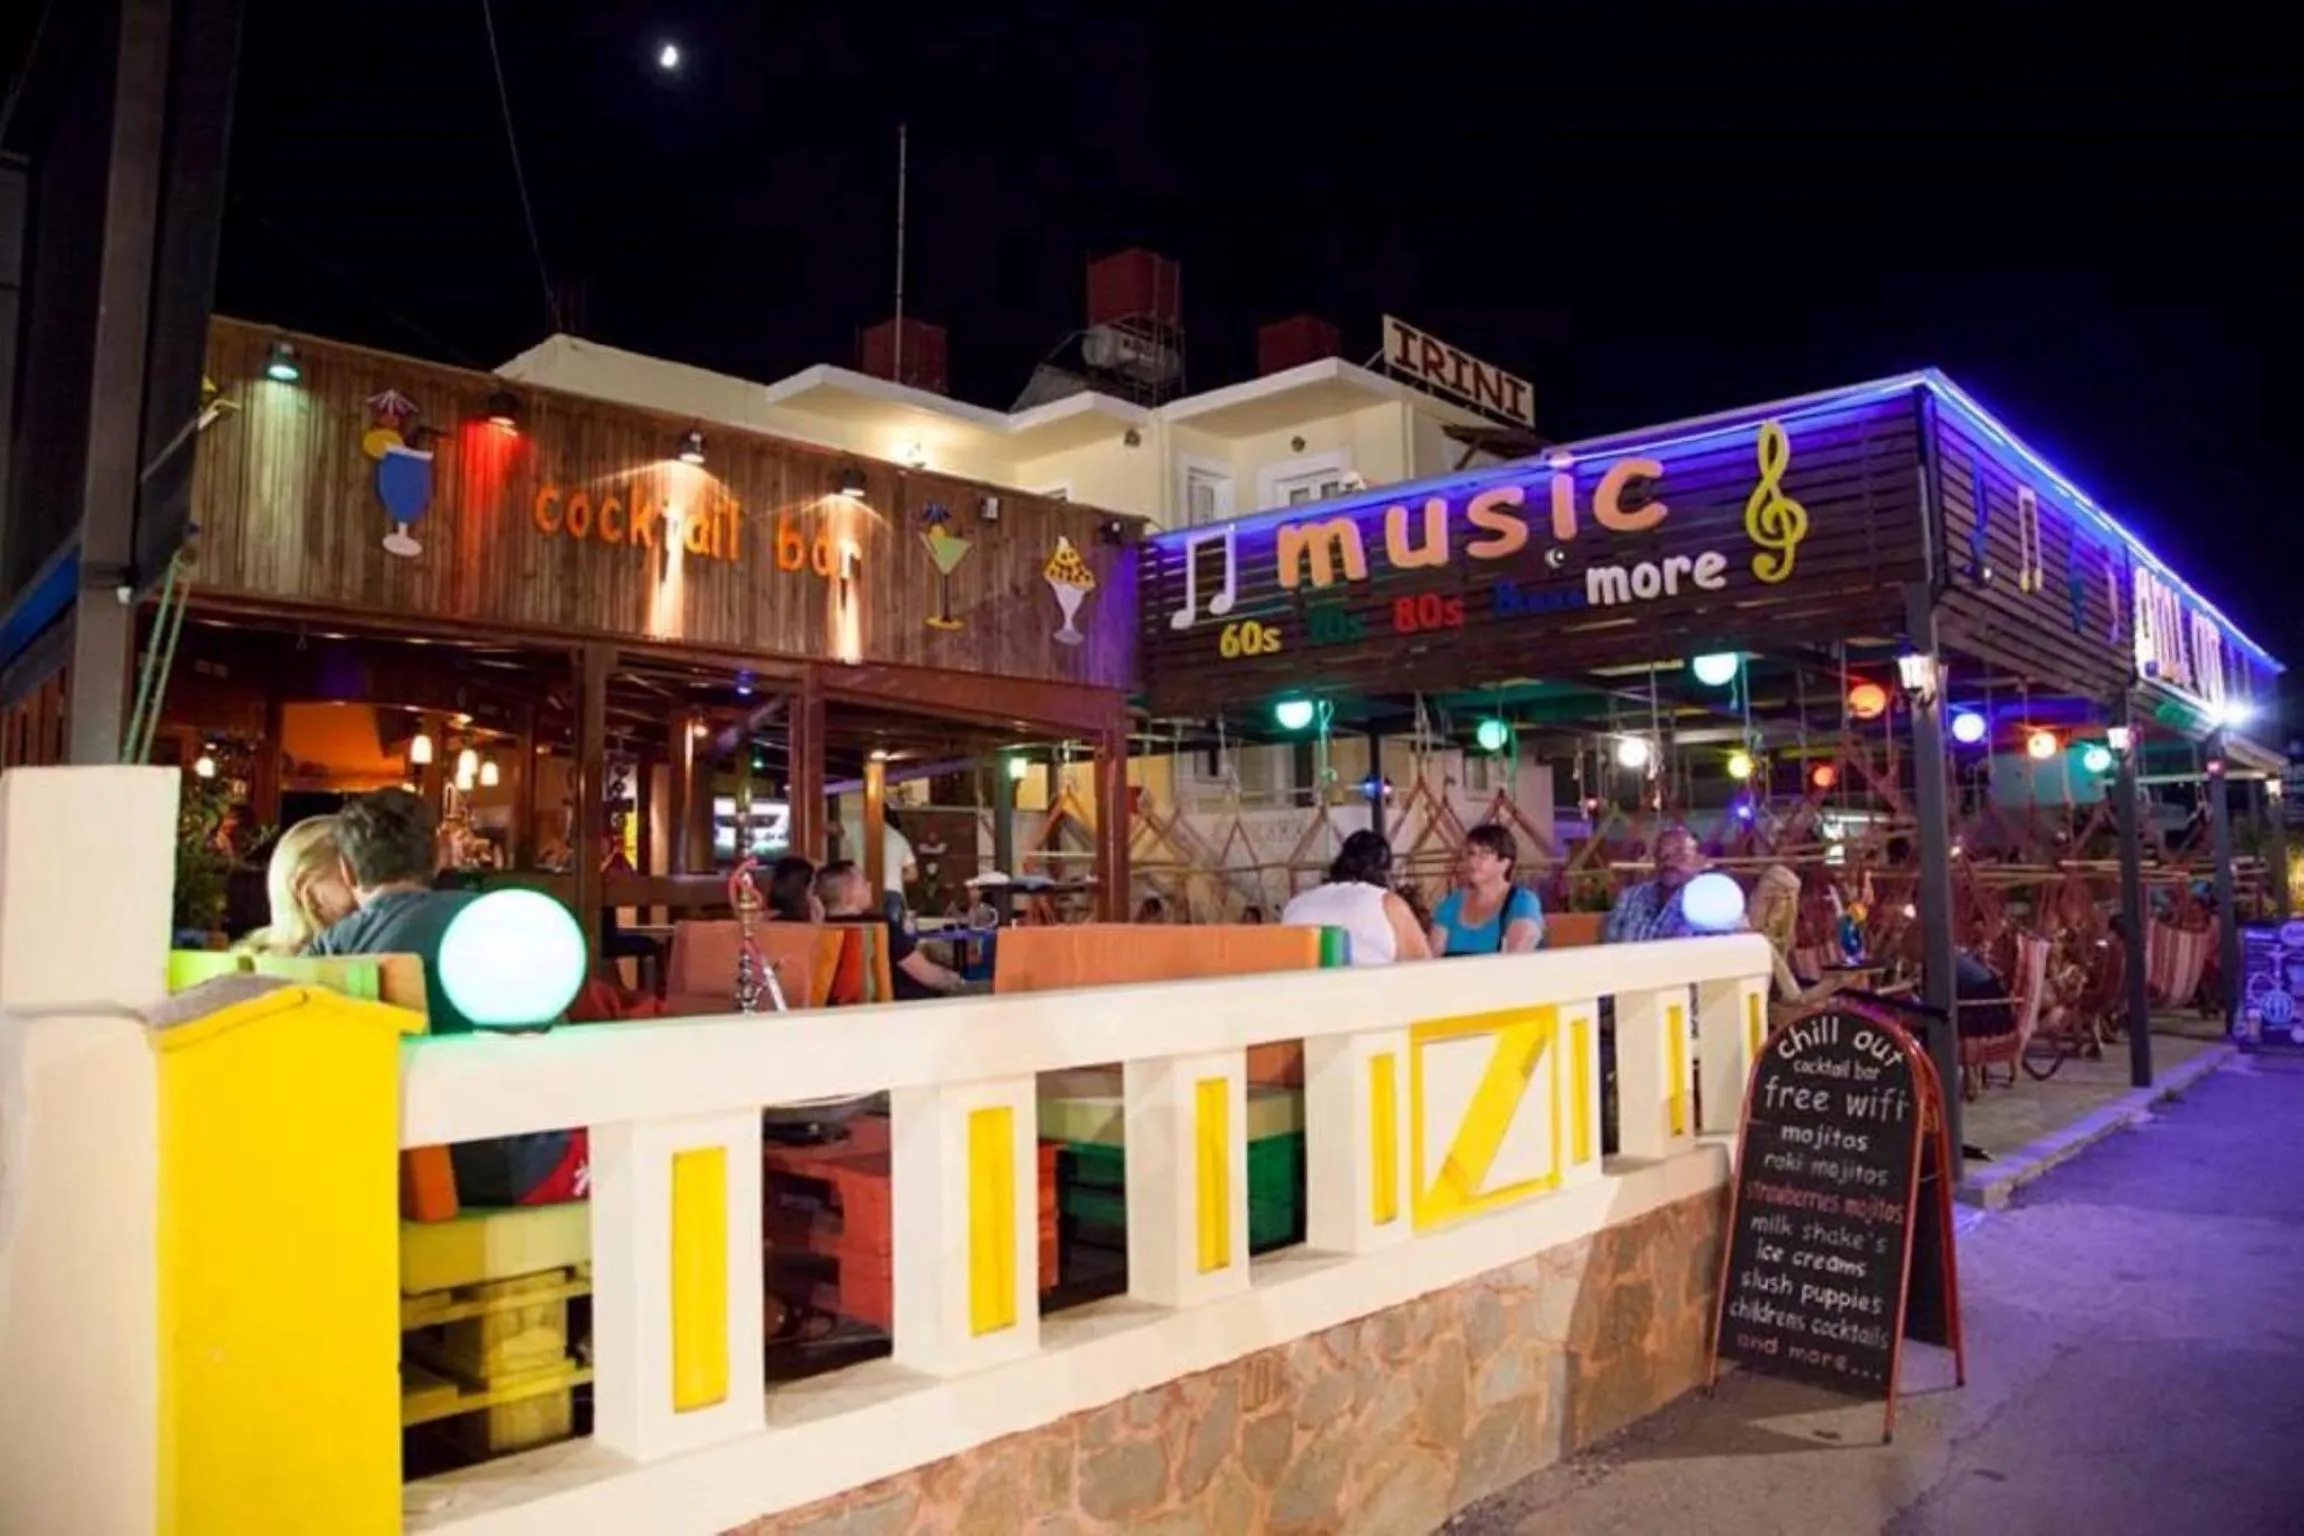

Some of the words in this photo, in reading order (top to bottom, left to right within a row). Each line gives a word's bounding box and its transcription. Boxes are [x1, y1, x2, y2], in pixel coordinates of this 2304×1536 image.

[1392, 321, 1527, 420] IRINI
[531, 482, 740, 562] cocktail
[775, 508, 863, 579] bar
[1276, 452, 1669, 588] music
[1219, 620, 1282, 658] 60s
[1394, 591, 1465, 633] 80s
[1586, 551, 1727, 605] more
[1778, 1016, 1839, 1059] chill
[1853, 1030, 1904, 1067] out
[1794, 1056, 1850, 1078] cocktail
[1853, 1059, 1882, 1080] bar
[1765, 1075, 1830, 1112] free
[1846, 1086, 1909, 1122] wifi
[1781, 1124, 1869, 1152] mojitos
[1811, 1158, 1889, 1187] mojitos
[1750, 1213, 1793, 1236] milk
[1756, 1237, 1785, 1262] ice
[1791, 1250, 1869, 1278] creams
[1741, 1266, 1793, 1295] slush
[1801, 1284, 1884, 1315] puppies
[1729, 1295, 1807, 1331] childrens
[1811, 1318, 1889, 1350] cocktails
[1737, 1333, 1779, 1355] and
